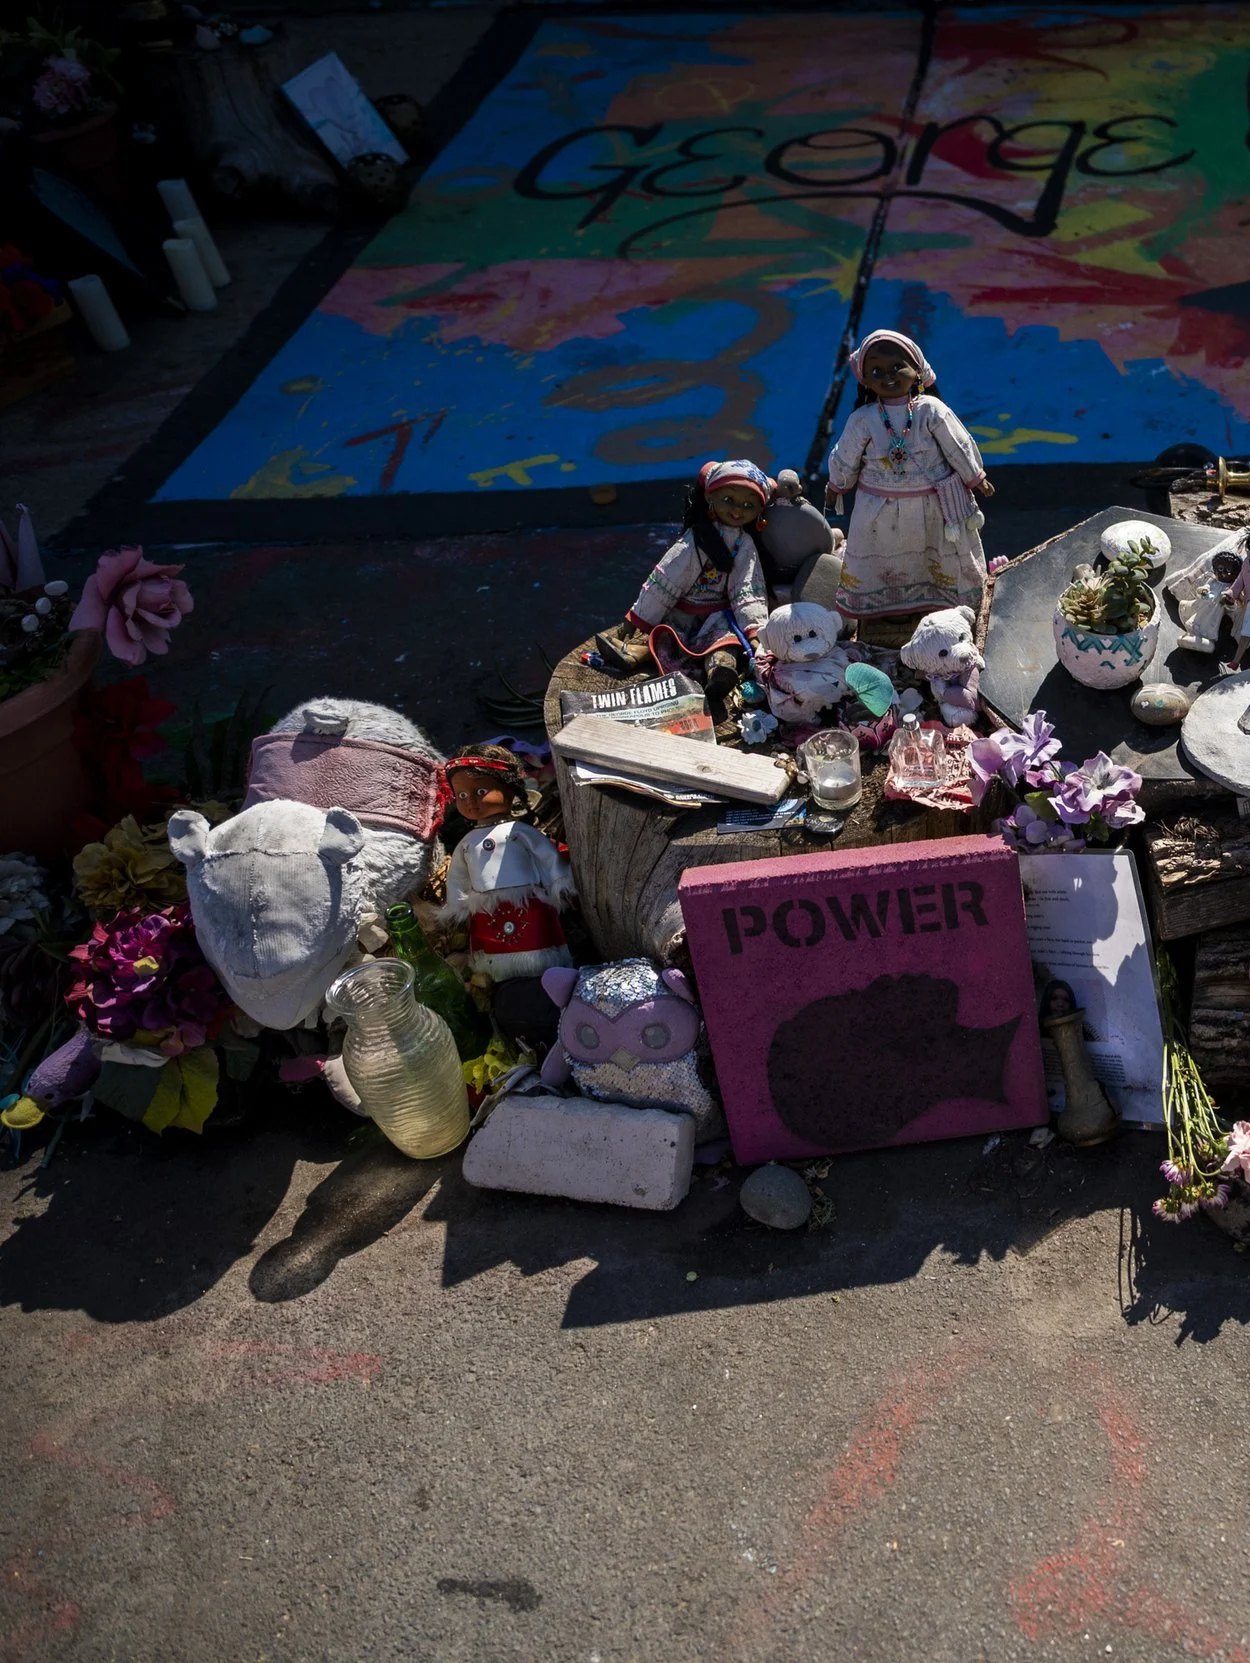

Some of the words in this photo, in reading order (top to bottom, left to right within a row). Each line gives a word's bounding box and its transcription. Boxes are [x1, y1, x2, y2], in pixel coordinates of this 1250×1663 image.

[590, 691, 627, 709] TWIN
[629, 678, 677, 705] FLAMES
[633, 707, 653, 715] FLOYD
[721, 880, 990, 955] POWER
